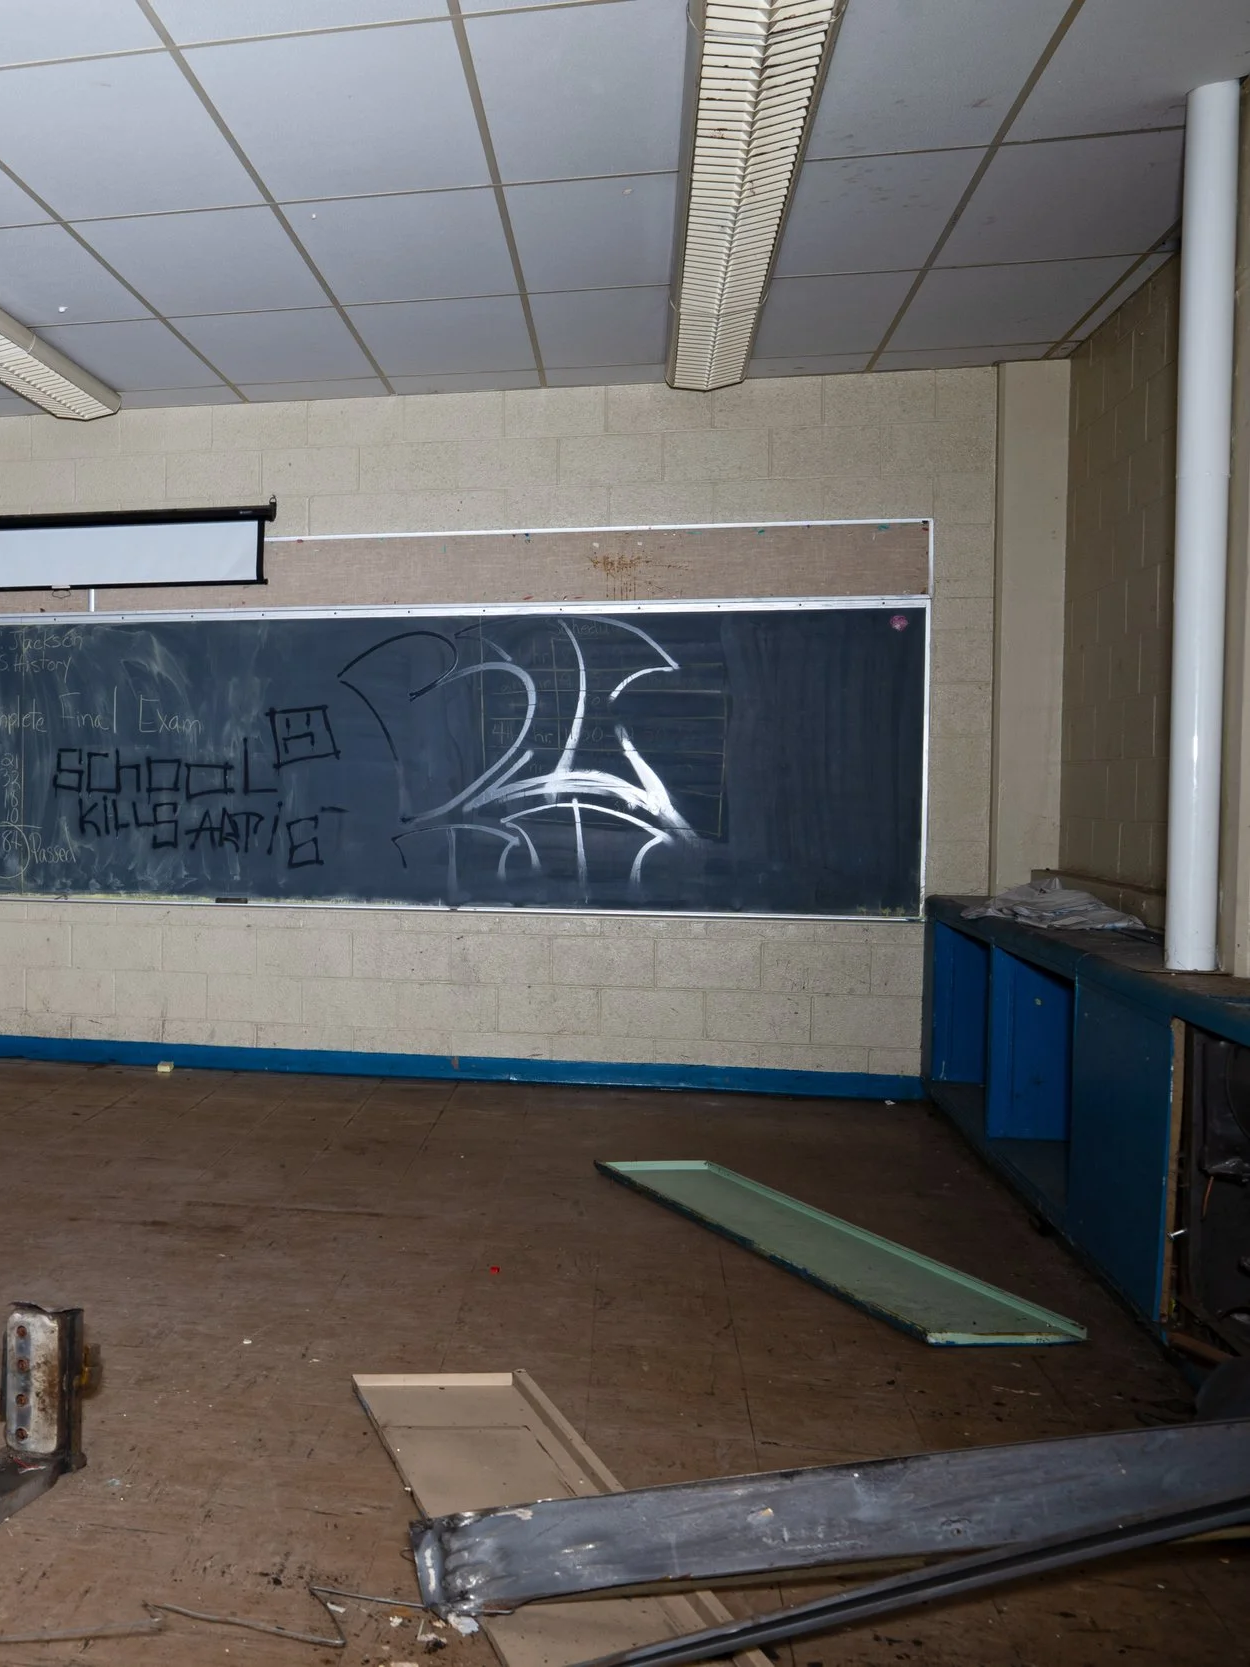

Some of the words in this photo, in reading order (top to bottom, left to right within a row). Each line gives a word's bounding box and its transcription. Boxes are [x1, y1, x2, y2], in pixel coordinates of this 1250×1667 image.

[8, 628, 84, 651] Jackson
[13, 655, 73, 684] History
[58, 685, 118, 735] Final
[138, 693, 204, 736] Exam
[6, 807, 20, 824] 10
[29, 831, 77, 865] Passed
